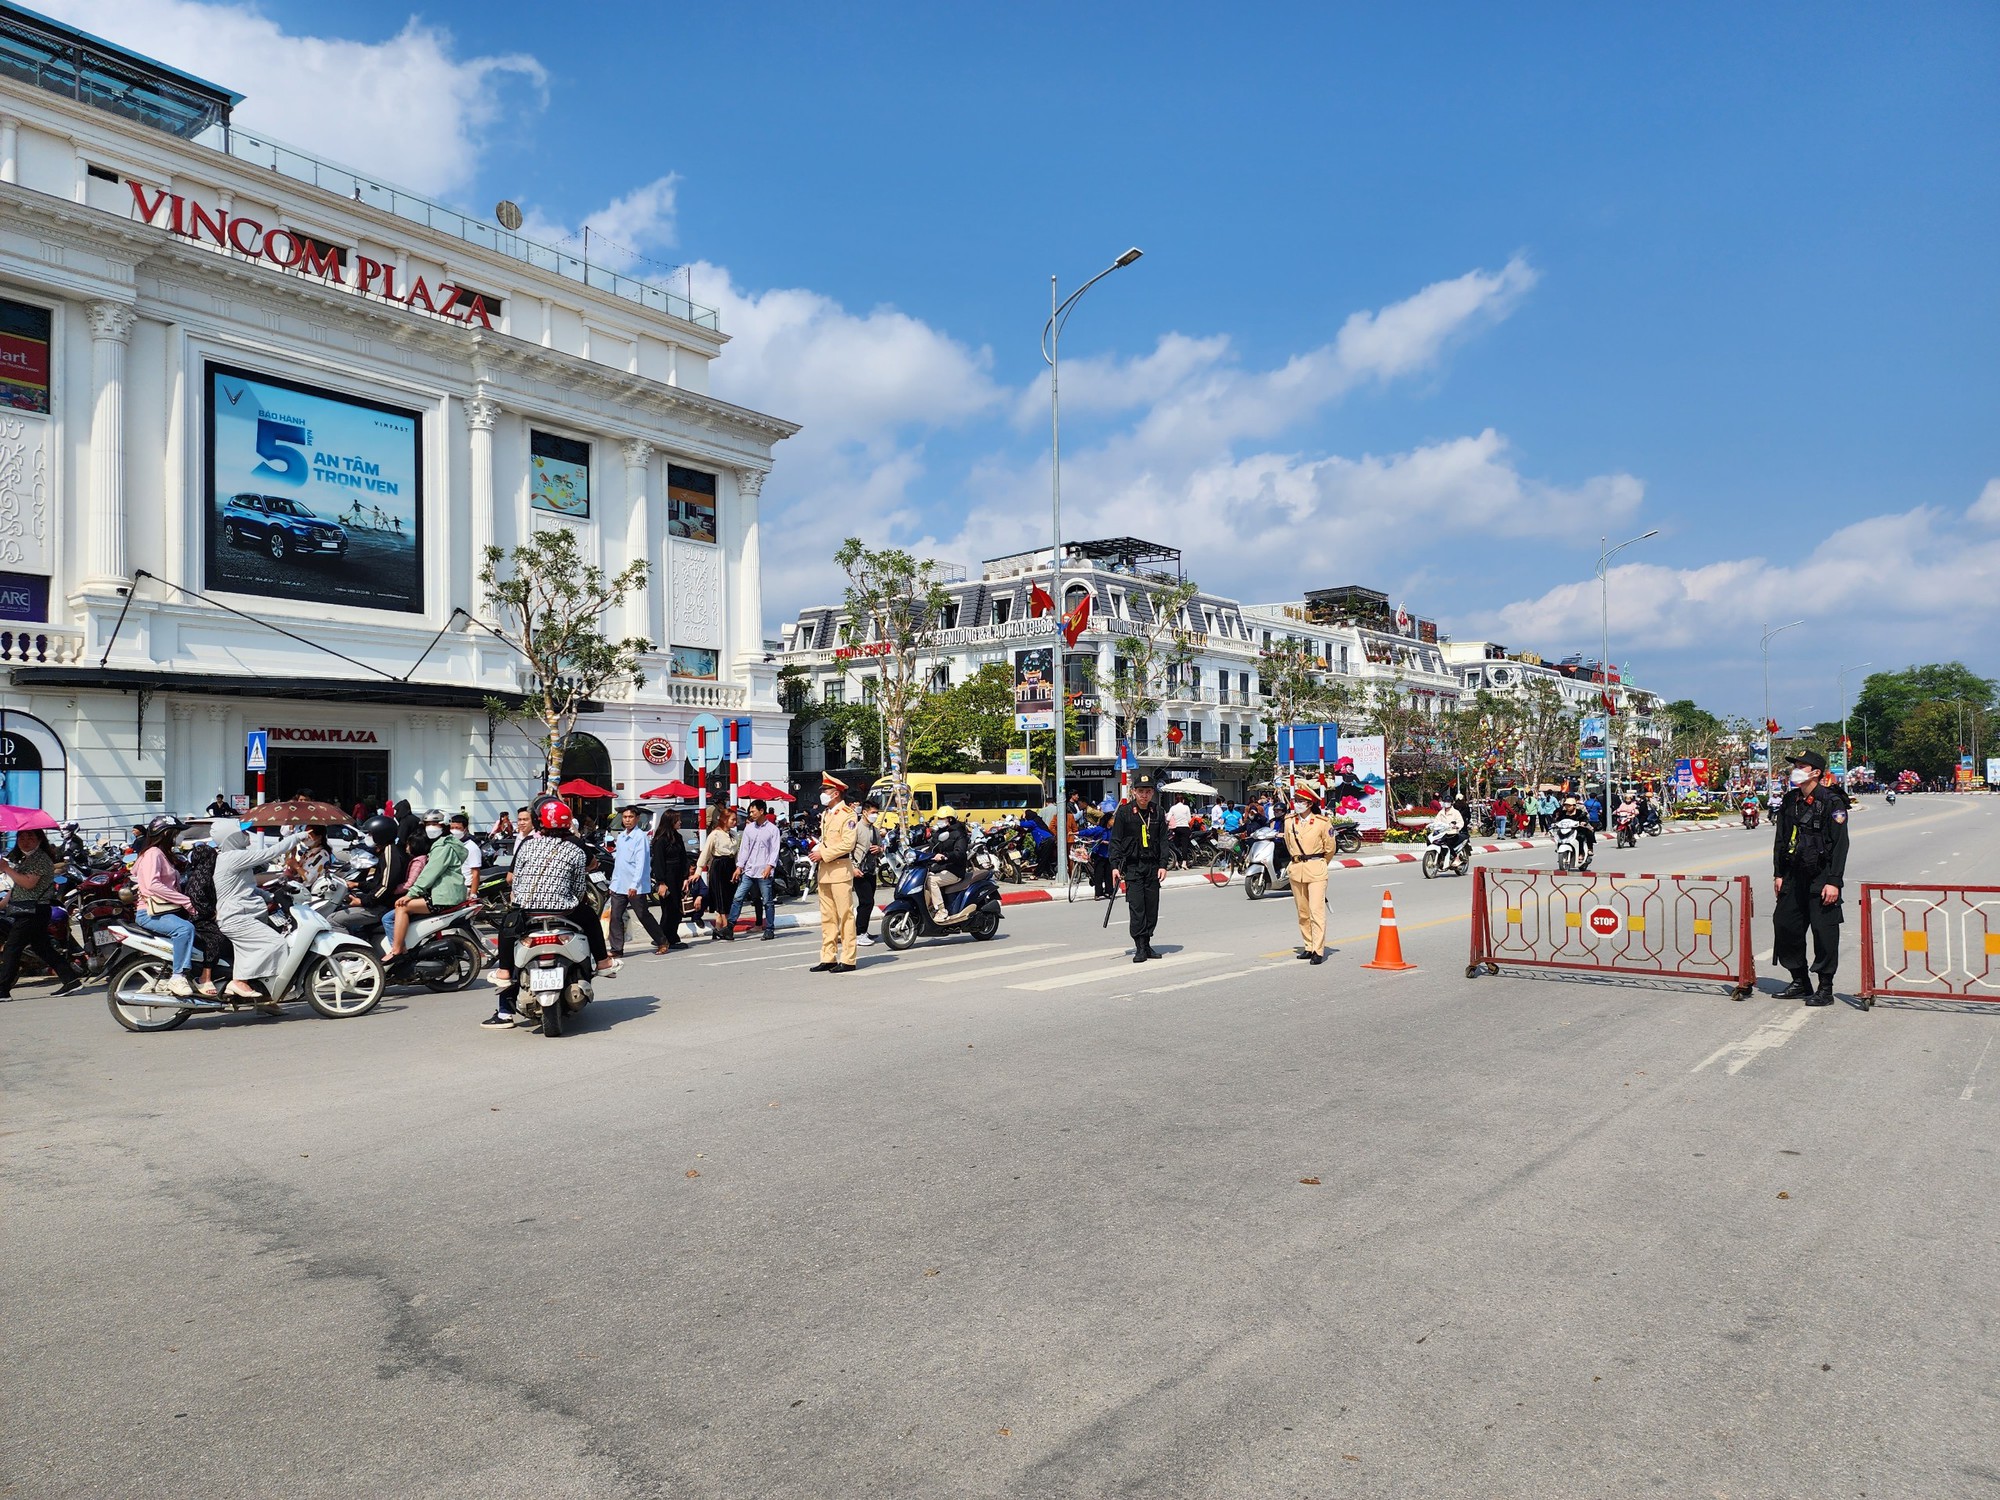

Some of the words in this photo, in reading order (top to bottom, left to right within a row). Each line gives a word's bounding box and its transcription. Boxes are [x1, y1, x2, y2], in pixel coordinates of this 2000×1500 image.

[125, 180, 345, 283] VINCOM
[354, 254, 493, 330] PLAZA
[0, 348, 27, 365] art
[374, 420, 409, 433] VINFAST
[250, 417, 308, 489] 5
[313, 451, 340, 469] AN
[342, 455, 380, 477] TÂM
[0, 590, 29, 607] ARE
[327, 729, 378, 743] PLAZA
[0, 757, 17, 765] LY
[648, 755, 669, 763] COFFEE
[1593, 916, 1615, 926] STOP
[533, 979, 561, 989] 084.92
